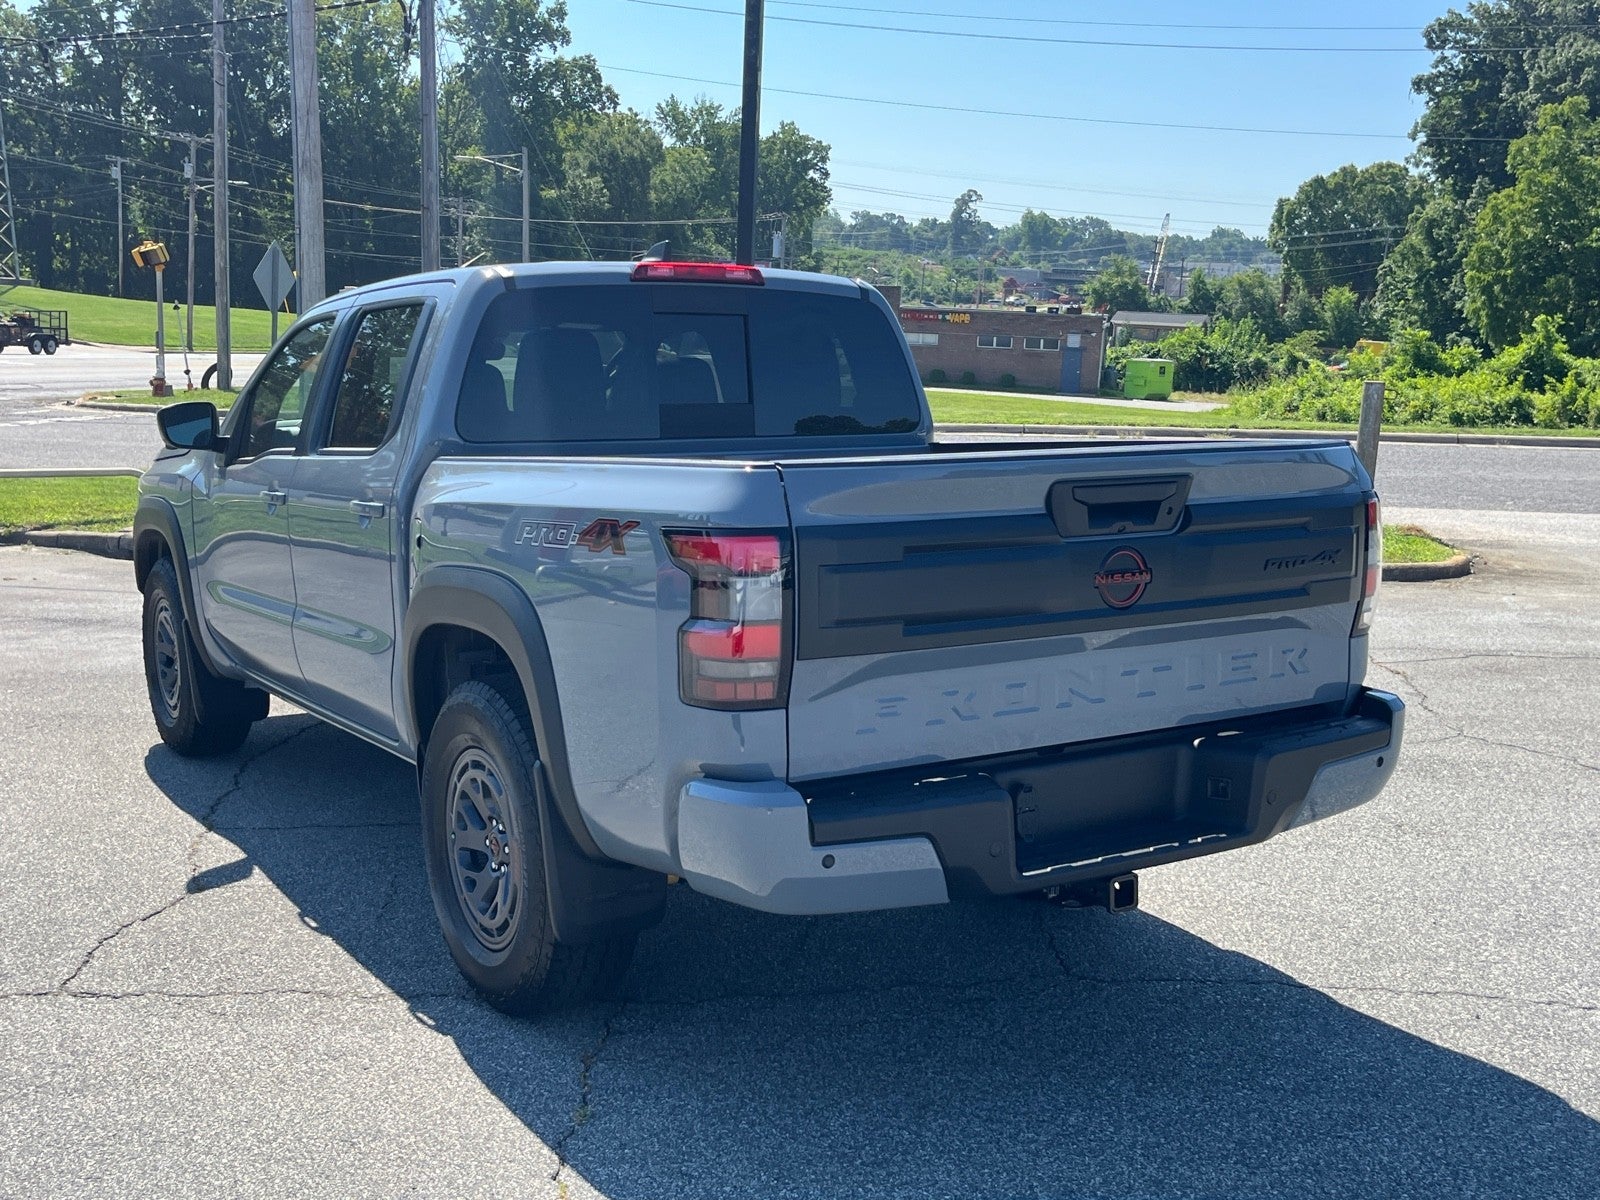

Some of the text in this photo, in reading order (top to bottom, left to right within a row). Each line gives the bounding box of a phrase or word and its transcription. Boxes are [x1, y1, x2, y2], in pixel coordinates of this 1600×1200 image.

[949, 312, 970, 323] VAPE
[1095, 571, 1151, 587] NISSAN
[855, 645, 1310, 734] FRONTIER
